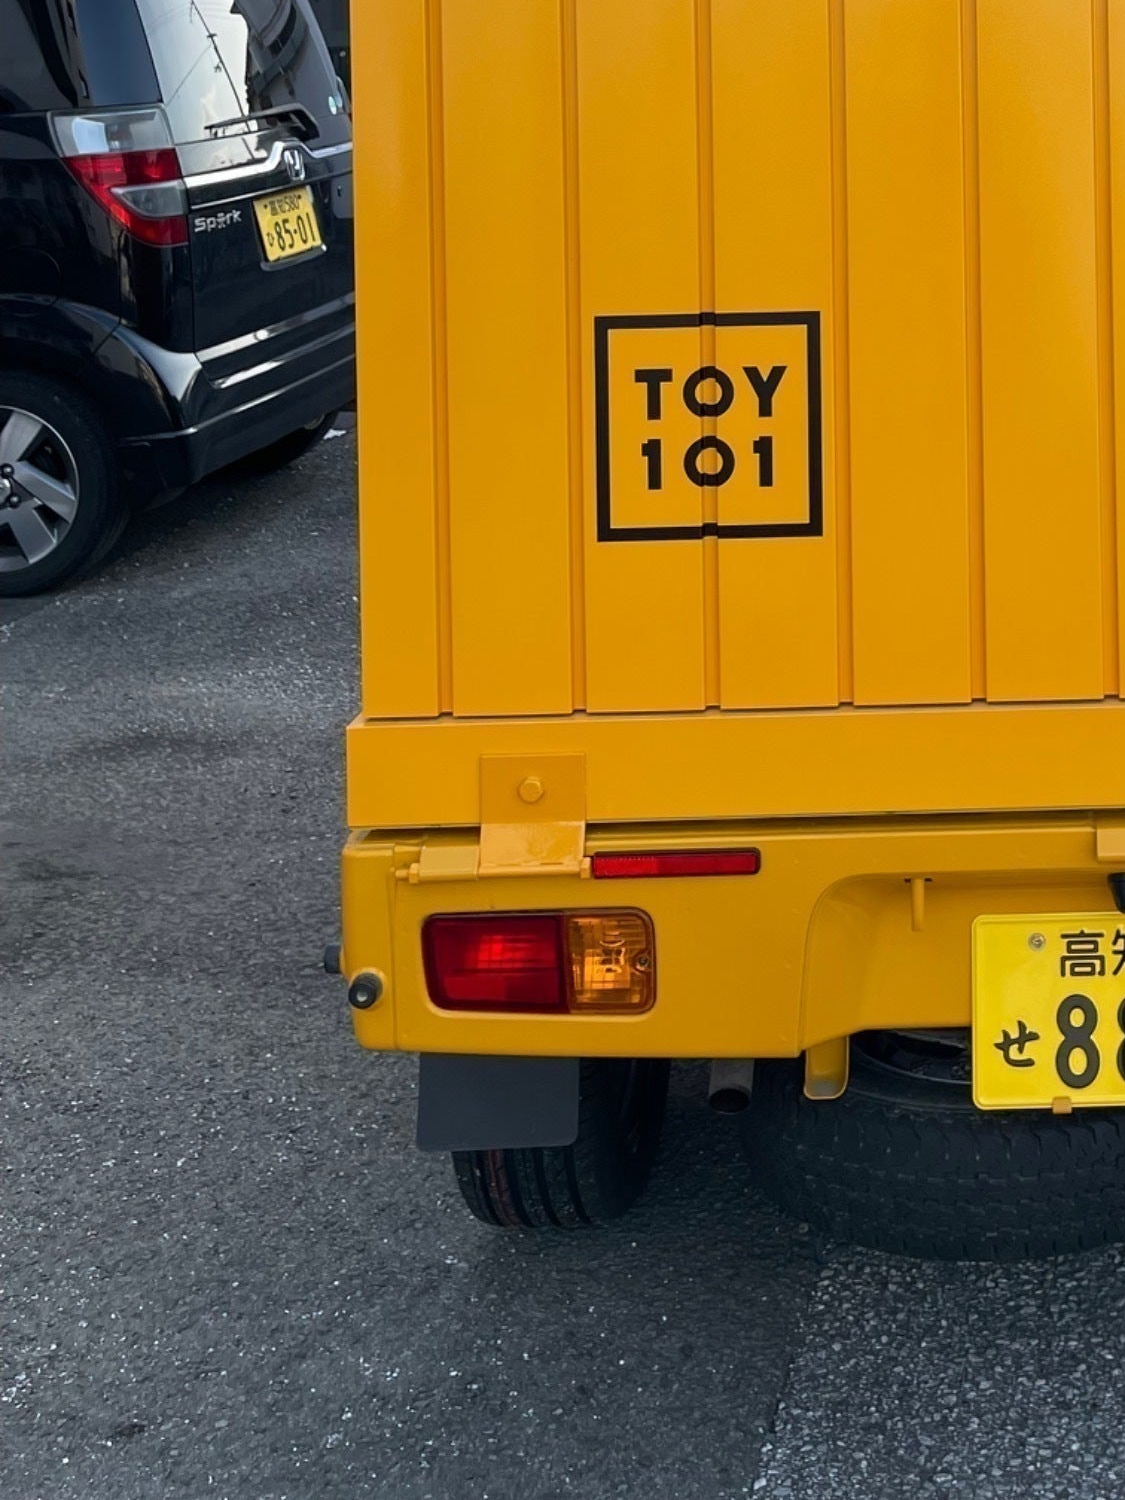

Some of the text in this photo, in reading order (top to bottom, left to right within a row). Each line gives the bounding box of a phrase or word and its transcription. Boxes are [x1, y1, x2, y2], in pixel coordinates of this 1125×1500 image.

[274, 212, 316, 252] 85-01
[634, 365, 788, 421] TOY
[641, 435, 774, 490] 101
[994, 1020, 1040, 1068] せ
